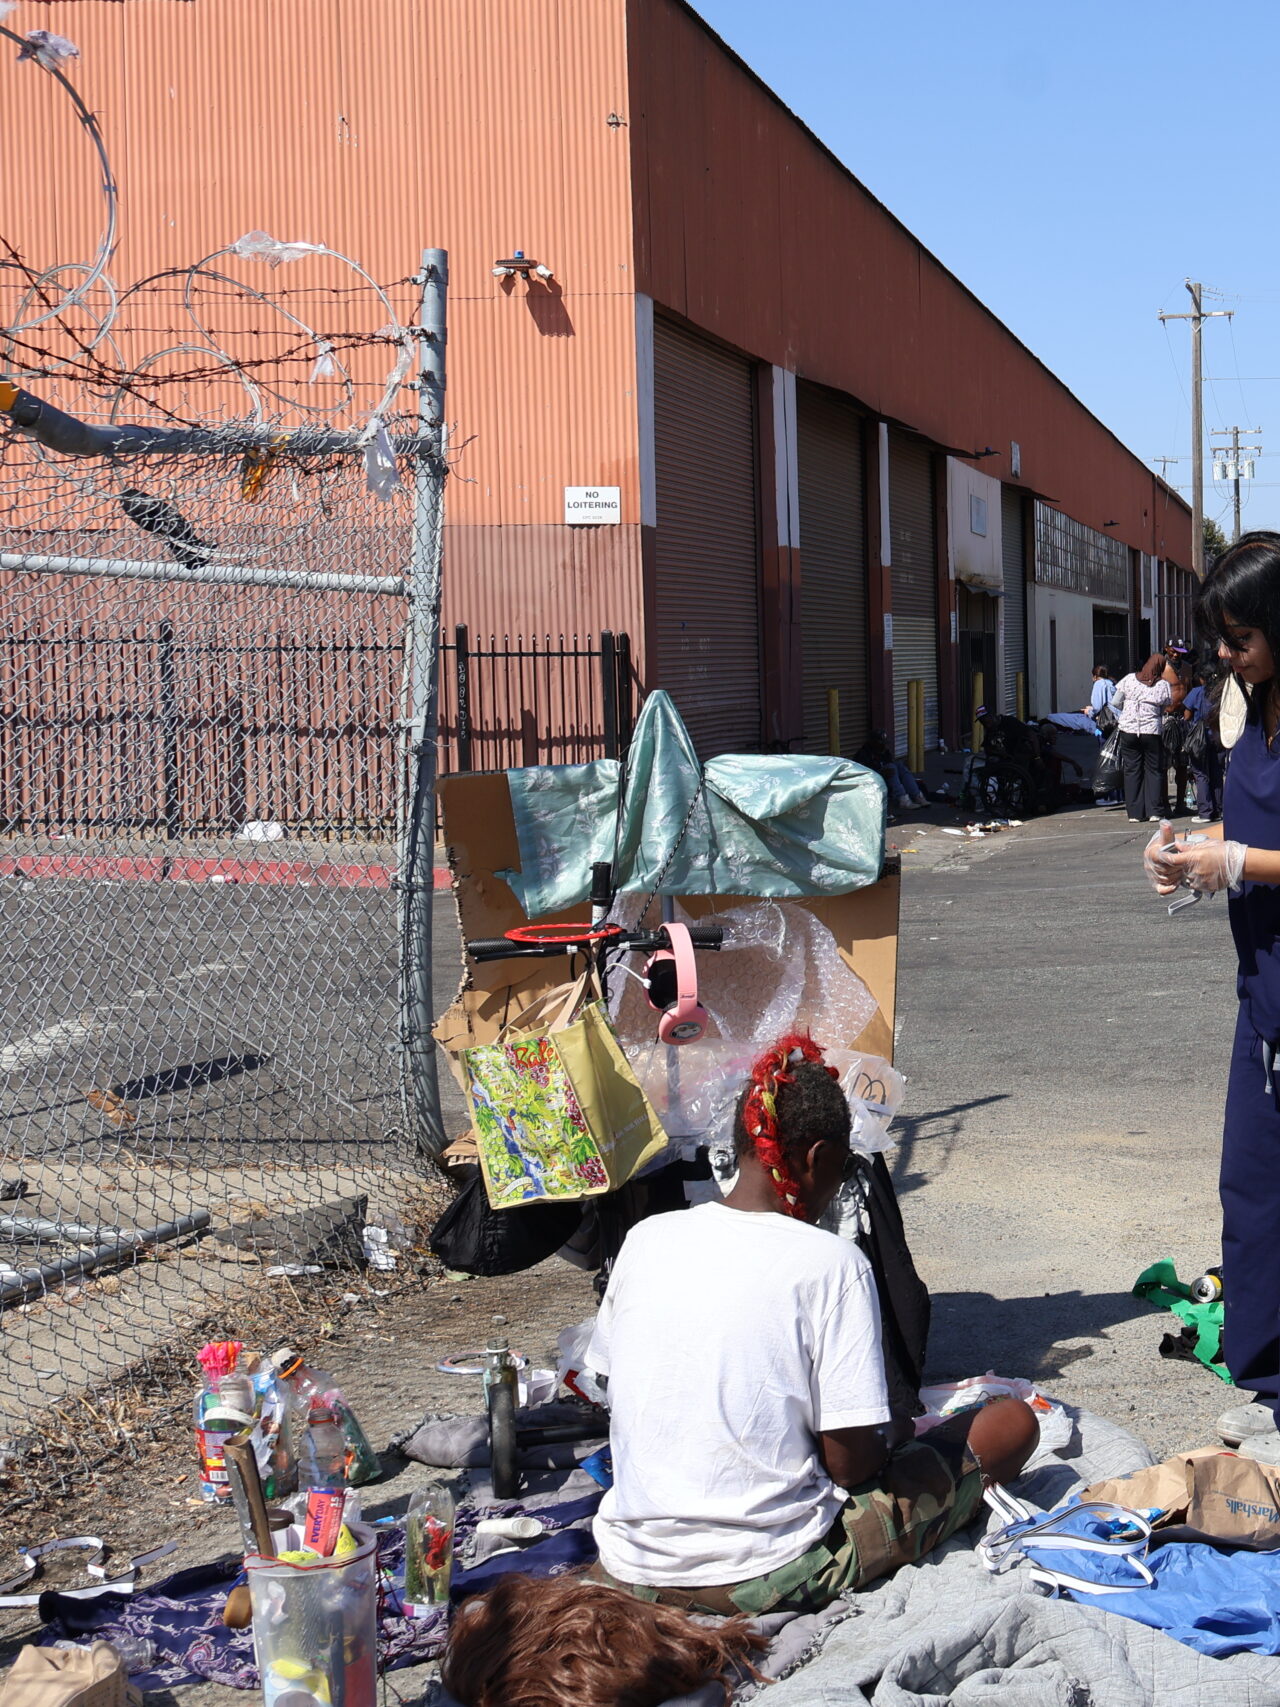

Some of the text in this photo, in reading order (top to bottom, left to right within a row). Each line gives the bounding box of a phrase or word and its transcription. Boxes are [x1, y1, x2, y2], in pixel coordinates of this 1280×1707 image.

[585, 491, 599, 499] NO
[567, 501, 618, 509] LOITERING
[1226, 1498, 1280, 1523] Marshalls
[311, 1500, 325, 1543] EVERYDAY
